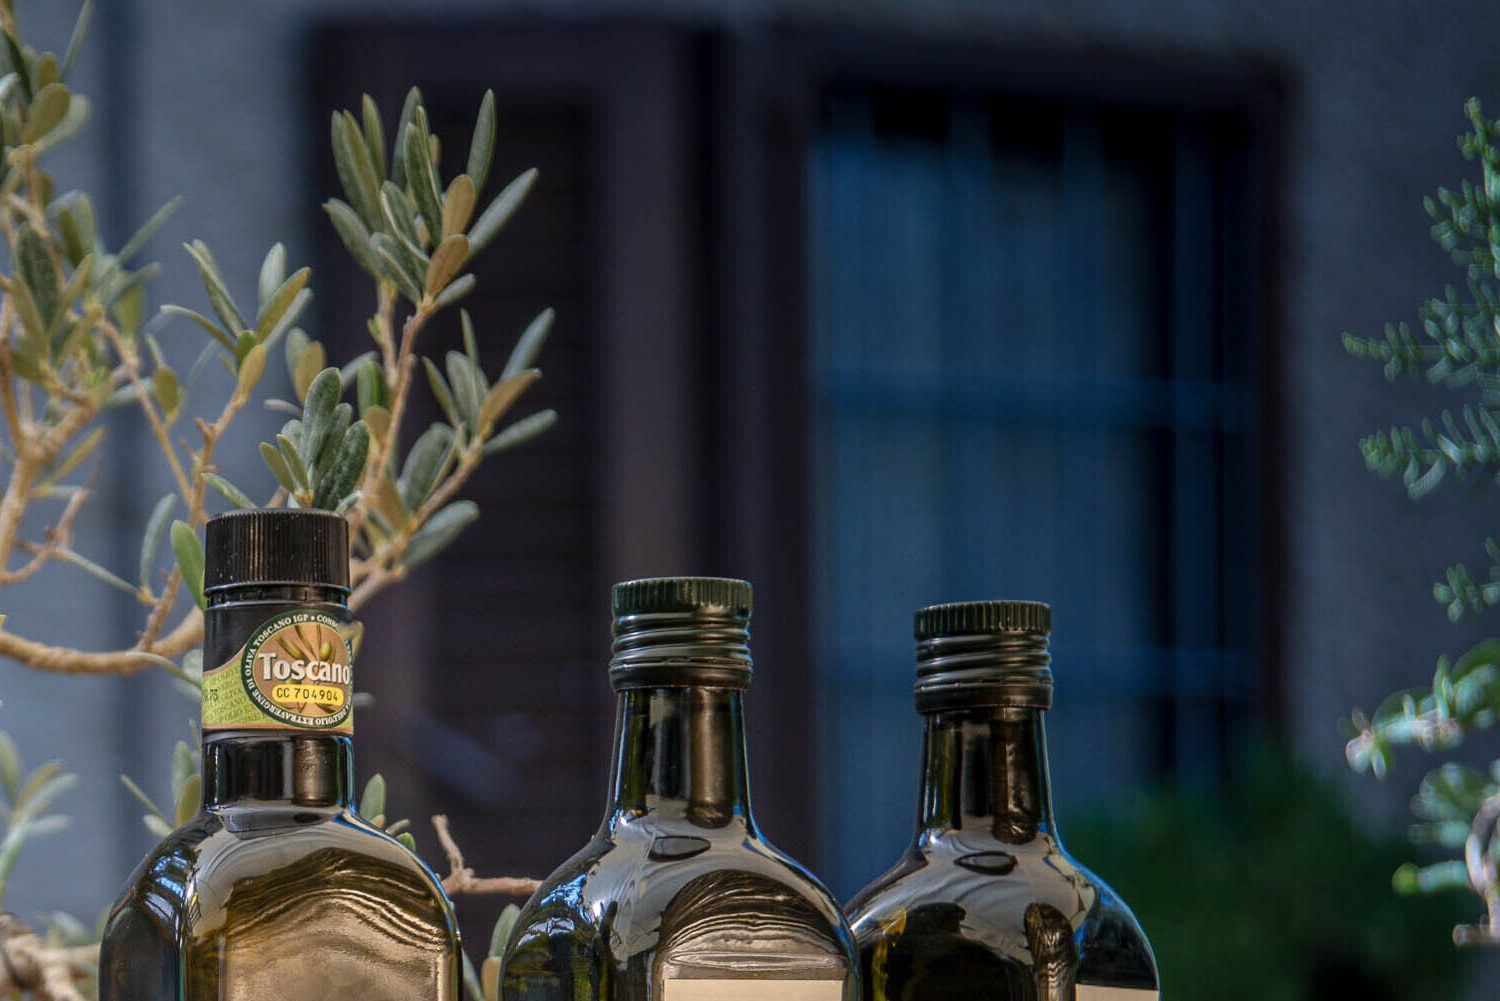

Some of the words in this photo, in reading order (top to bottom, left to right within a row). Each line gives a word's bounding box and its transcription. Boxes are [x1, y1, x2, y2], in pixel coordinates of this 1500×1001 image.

[244, 648, 256, 677] OLIVA
[253, 615, 292, 647] TOSCANO
[292, 613, 309, 624] IGP
[259, 652, 350, 685] Toscano
[276, 687, 290, 698] CC
[294, 688, 339, 701] 704904
